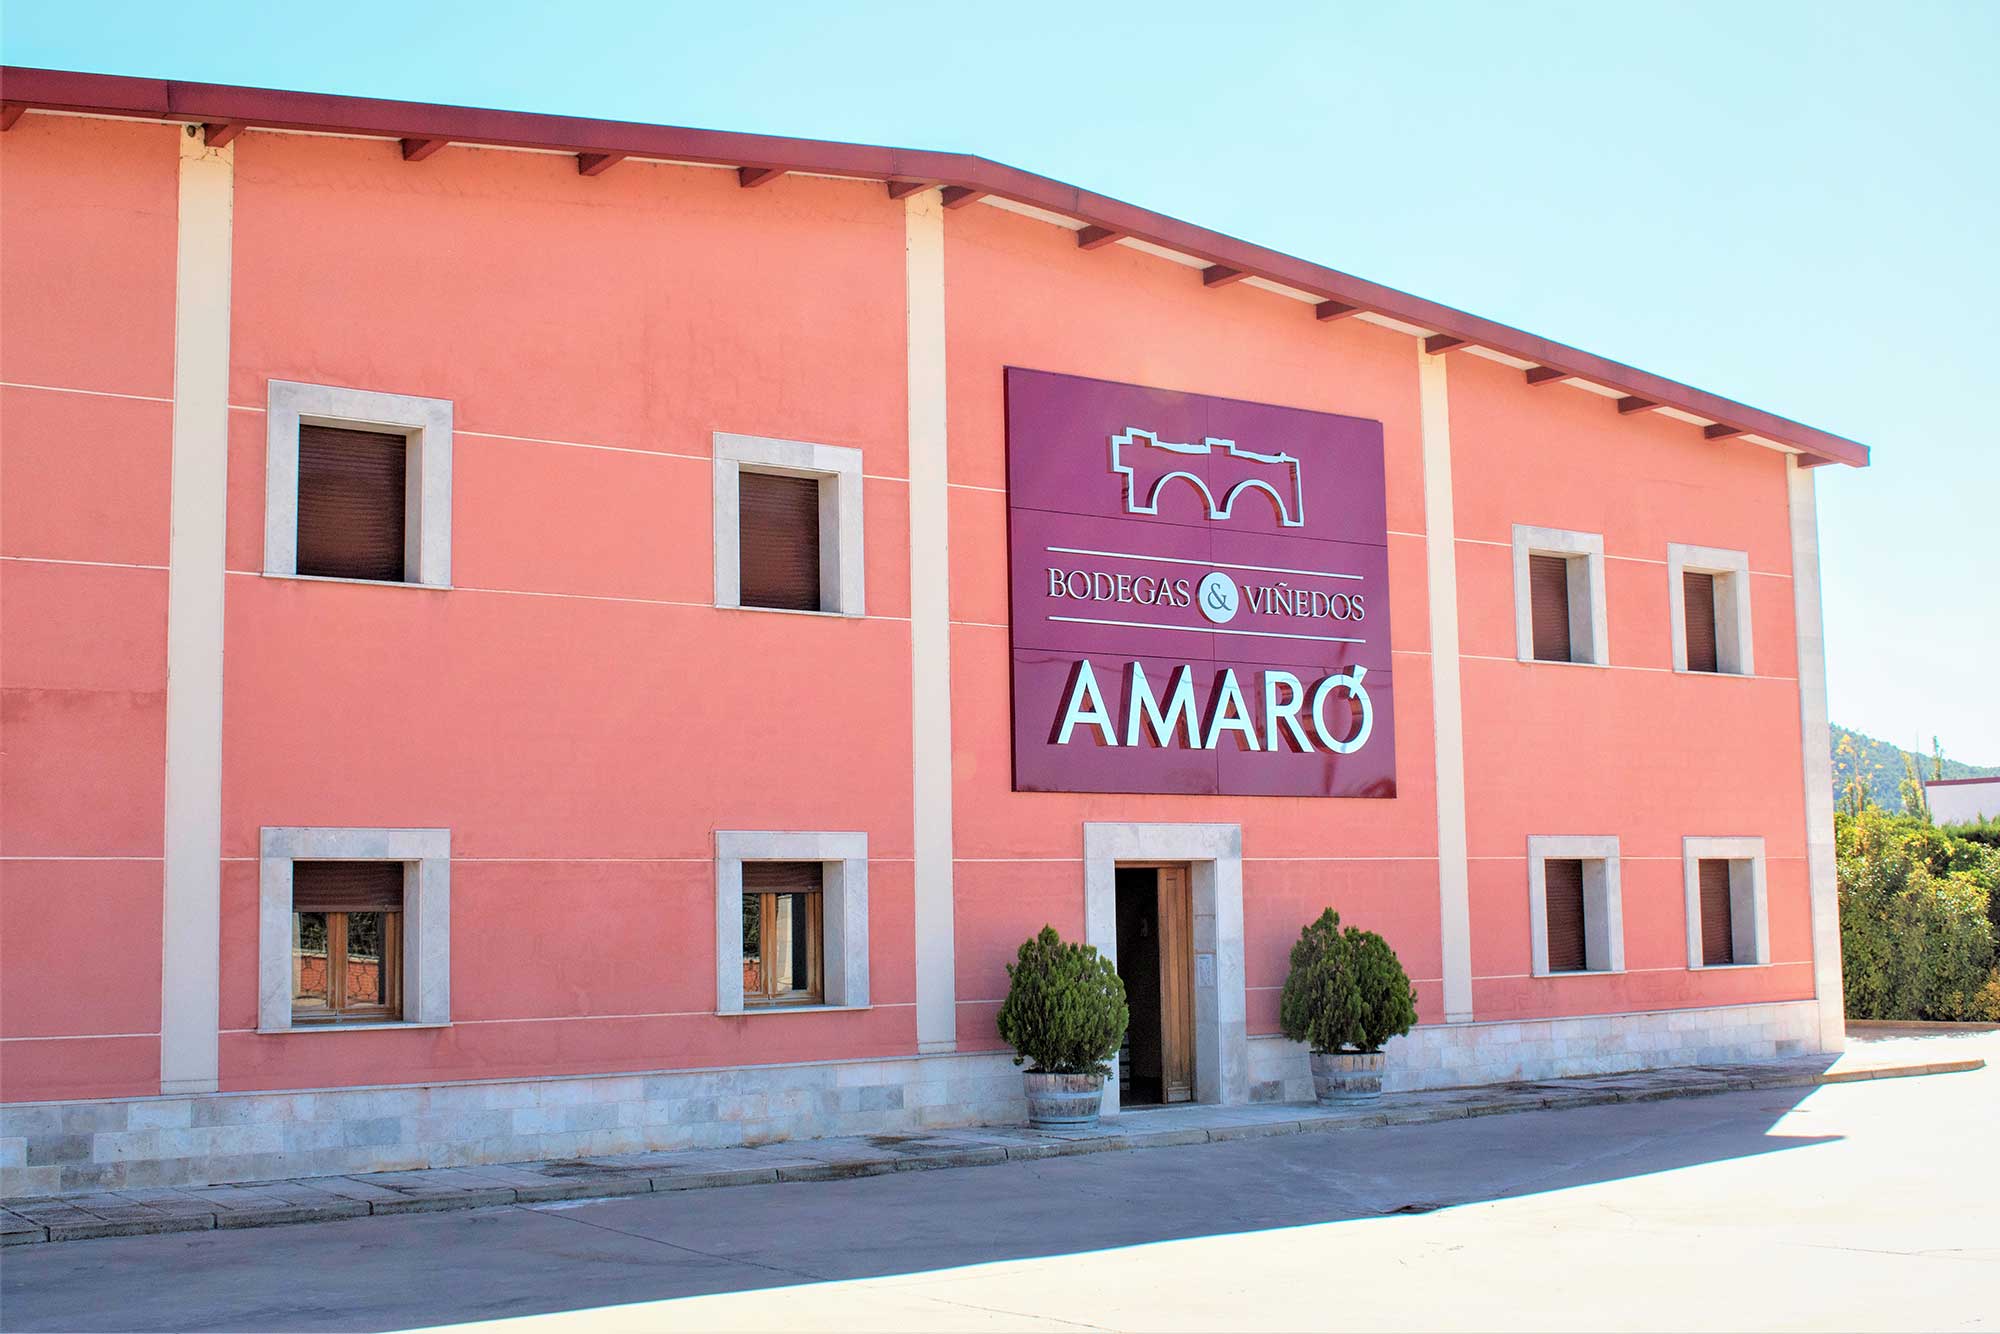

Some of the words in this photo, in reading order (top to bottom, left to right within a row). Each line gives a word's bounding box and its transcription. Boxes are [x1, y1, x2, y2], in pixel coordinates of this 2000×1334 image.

[1047, 568, 1191, 608] BODEGAS
[1207, 582, 1232, 612] &
[1243, 583, 1366, 622] VIÑEDOS
[1055, 658, 1374, 755] AMARÓ
